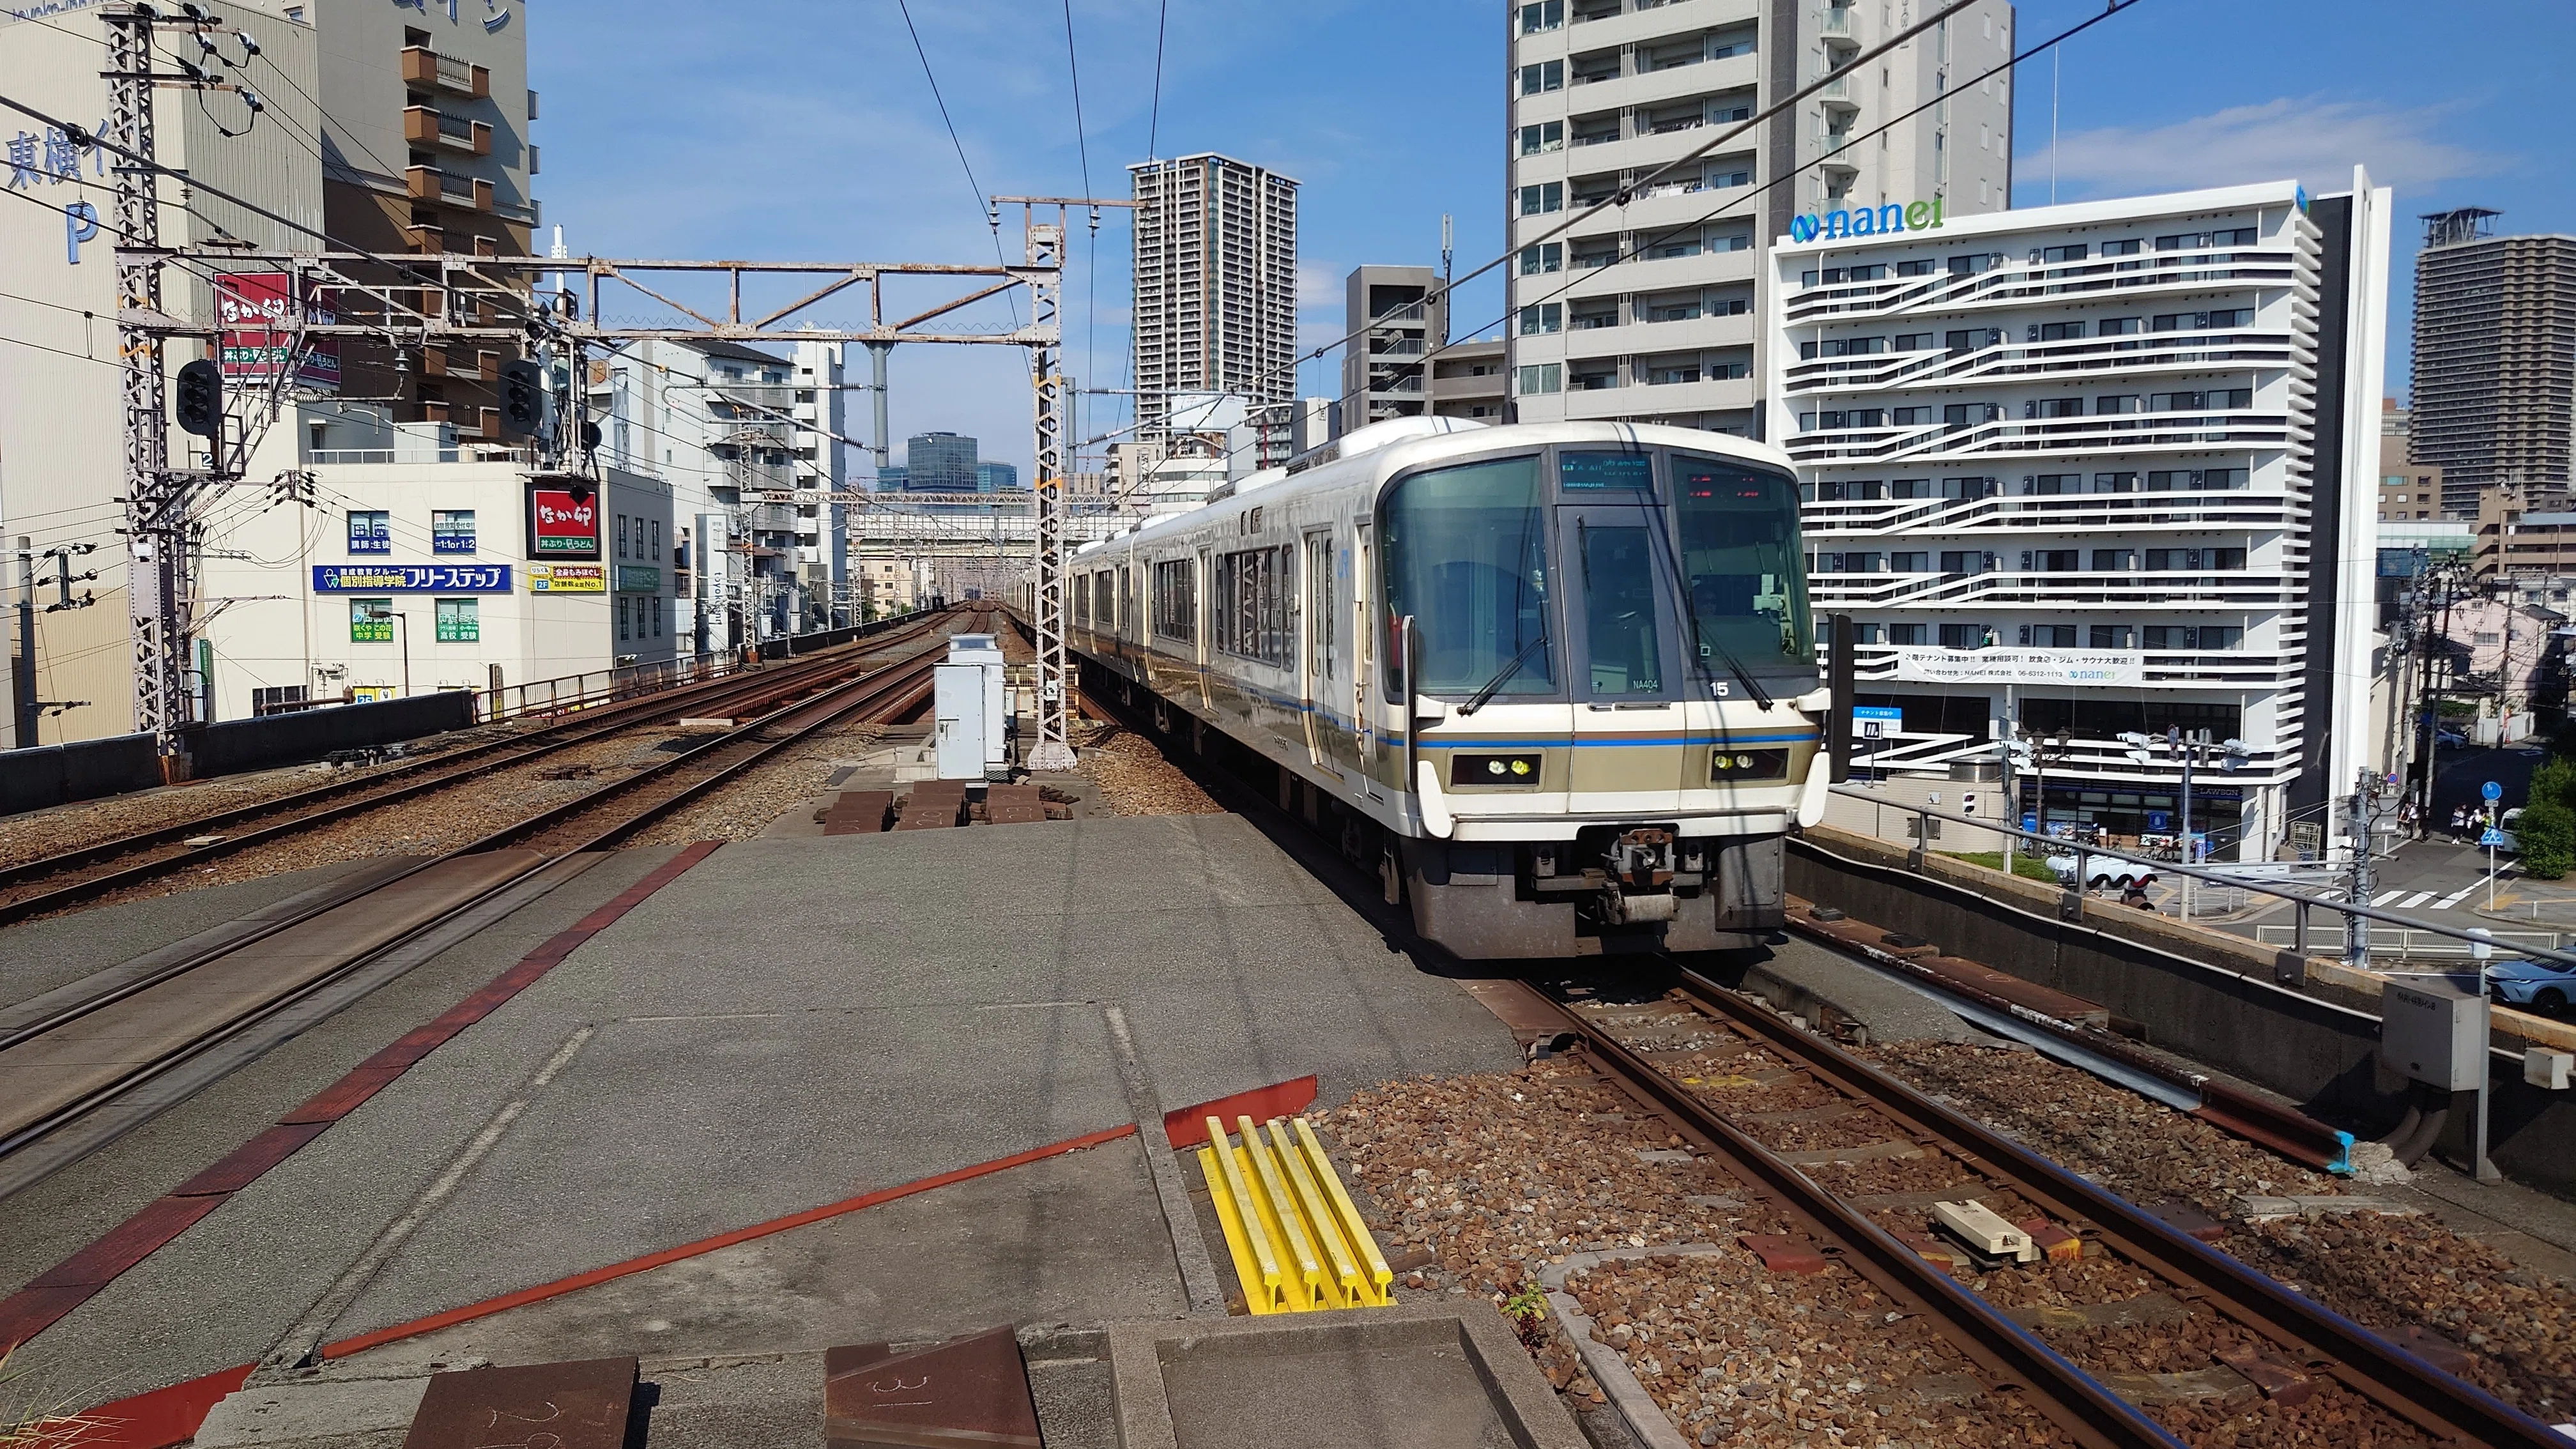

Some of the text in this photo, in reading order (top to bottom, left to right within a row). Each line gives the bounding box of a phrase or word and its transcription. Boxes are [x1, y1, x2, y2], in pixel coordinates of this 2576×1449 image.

[1825, 198, 1943, 240] nanei
[540, 505, 592, 528] なか卯
[341, 576, 406, 587] 個別指導学院
[407, 568, 501, 587] フリーステップ
[1633, 680, 1658, 689] NA404
[1710, 682, 1729, 696] 15
